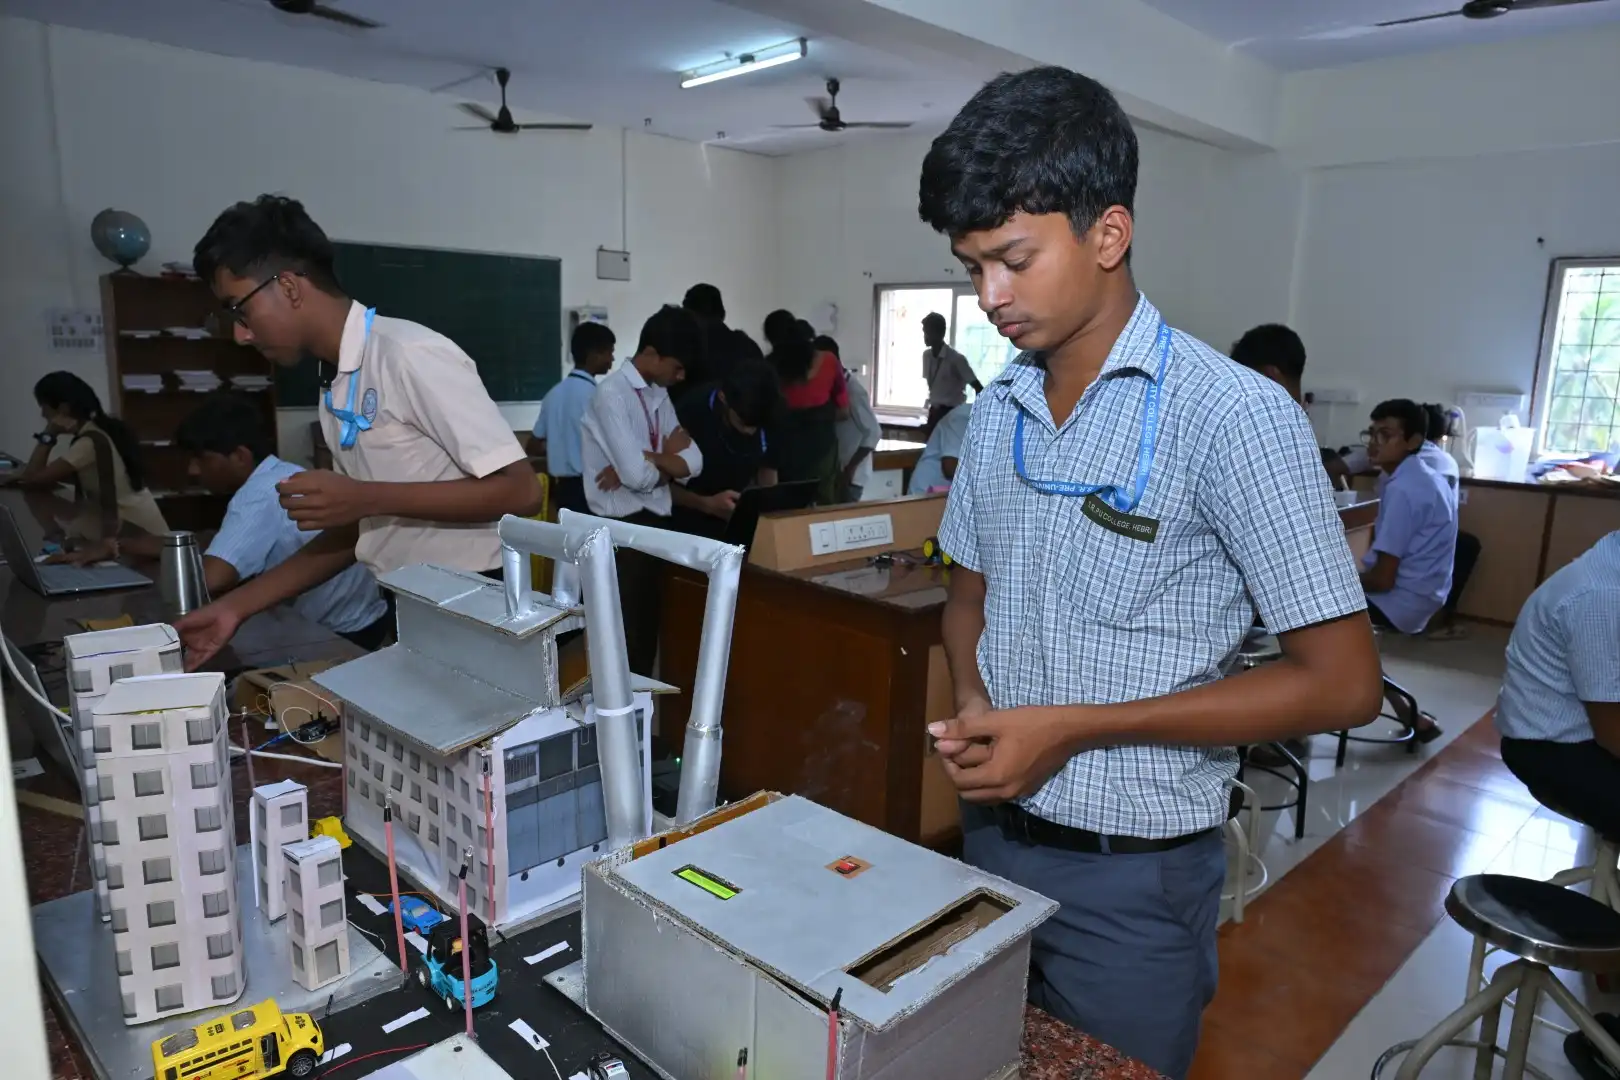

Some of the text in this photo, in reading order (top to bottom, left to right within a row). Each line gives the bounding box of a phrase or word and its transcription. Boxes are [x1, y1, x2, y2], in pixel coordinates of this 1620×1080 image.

[1144, 402, 1156, 445] COLLEGE
[1140, 447, 1151, 476] HEBRI
[1102, 512, 1131, 530] COLLEGE,
[1131, 523, 1153, 534] HEBRI
